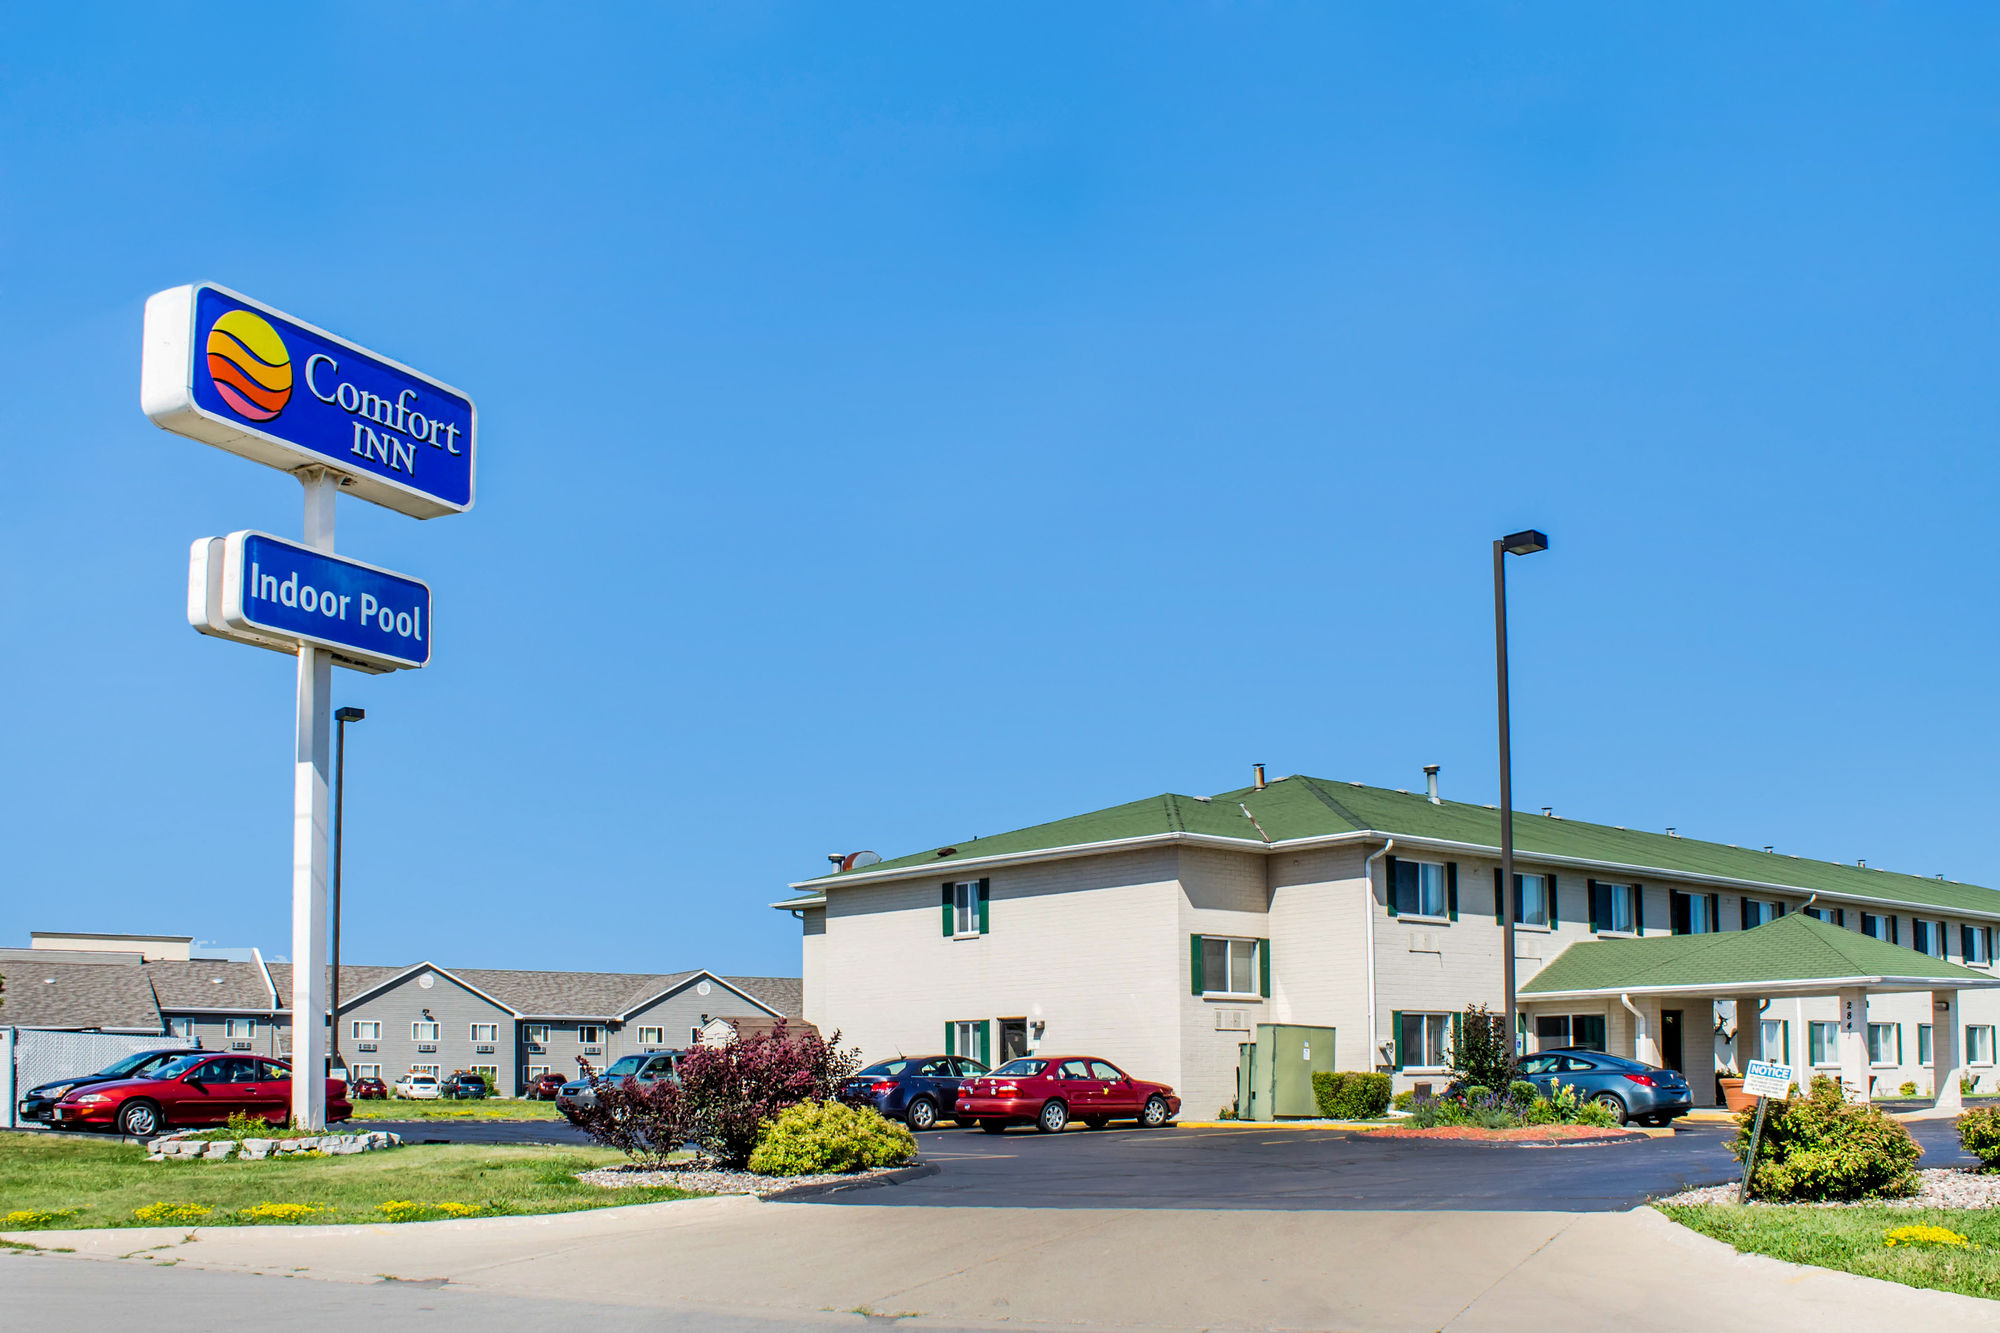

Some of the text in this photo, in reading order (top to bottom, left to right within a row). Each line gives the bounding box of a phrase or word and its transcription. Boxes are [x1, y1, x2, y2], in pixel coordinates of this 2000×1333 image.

[305, 353, 460, 454] Comfort
[351, 421, 416, 475] INN
[251, 563, 422, 641] Indoor Pool
[1751, 1064, 1790, 1079] NOTICE
